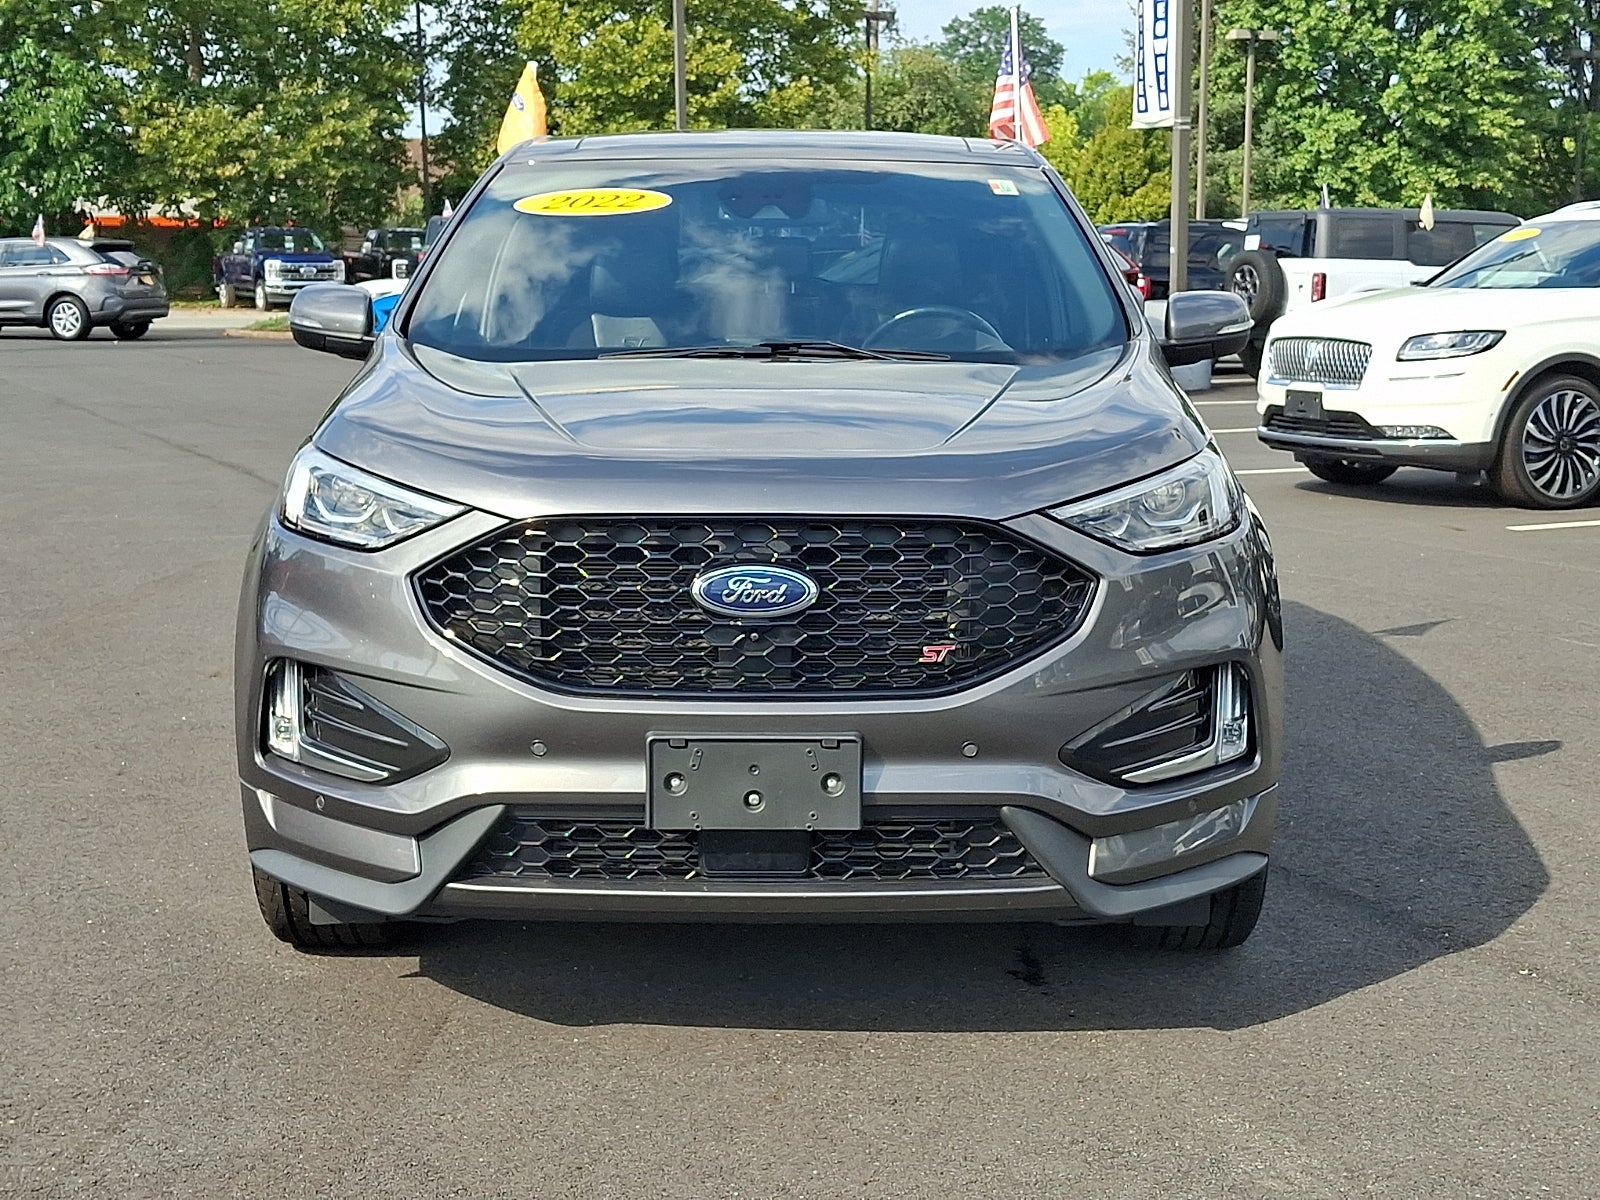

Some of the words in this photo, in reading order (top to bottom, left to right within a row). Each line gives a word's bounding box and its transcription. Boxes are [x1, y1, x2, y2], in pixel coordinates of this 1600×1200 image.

[541, 194, 646, 210] 2022
[722, 576, 788, 604] Ford
[918, 644, 956, 663] ST
